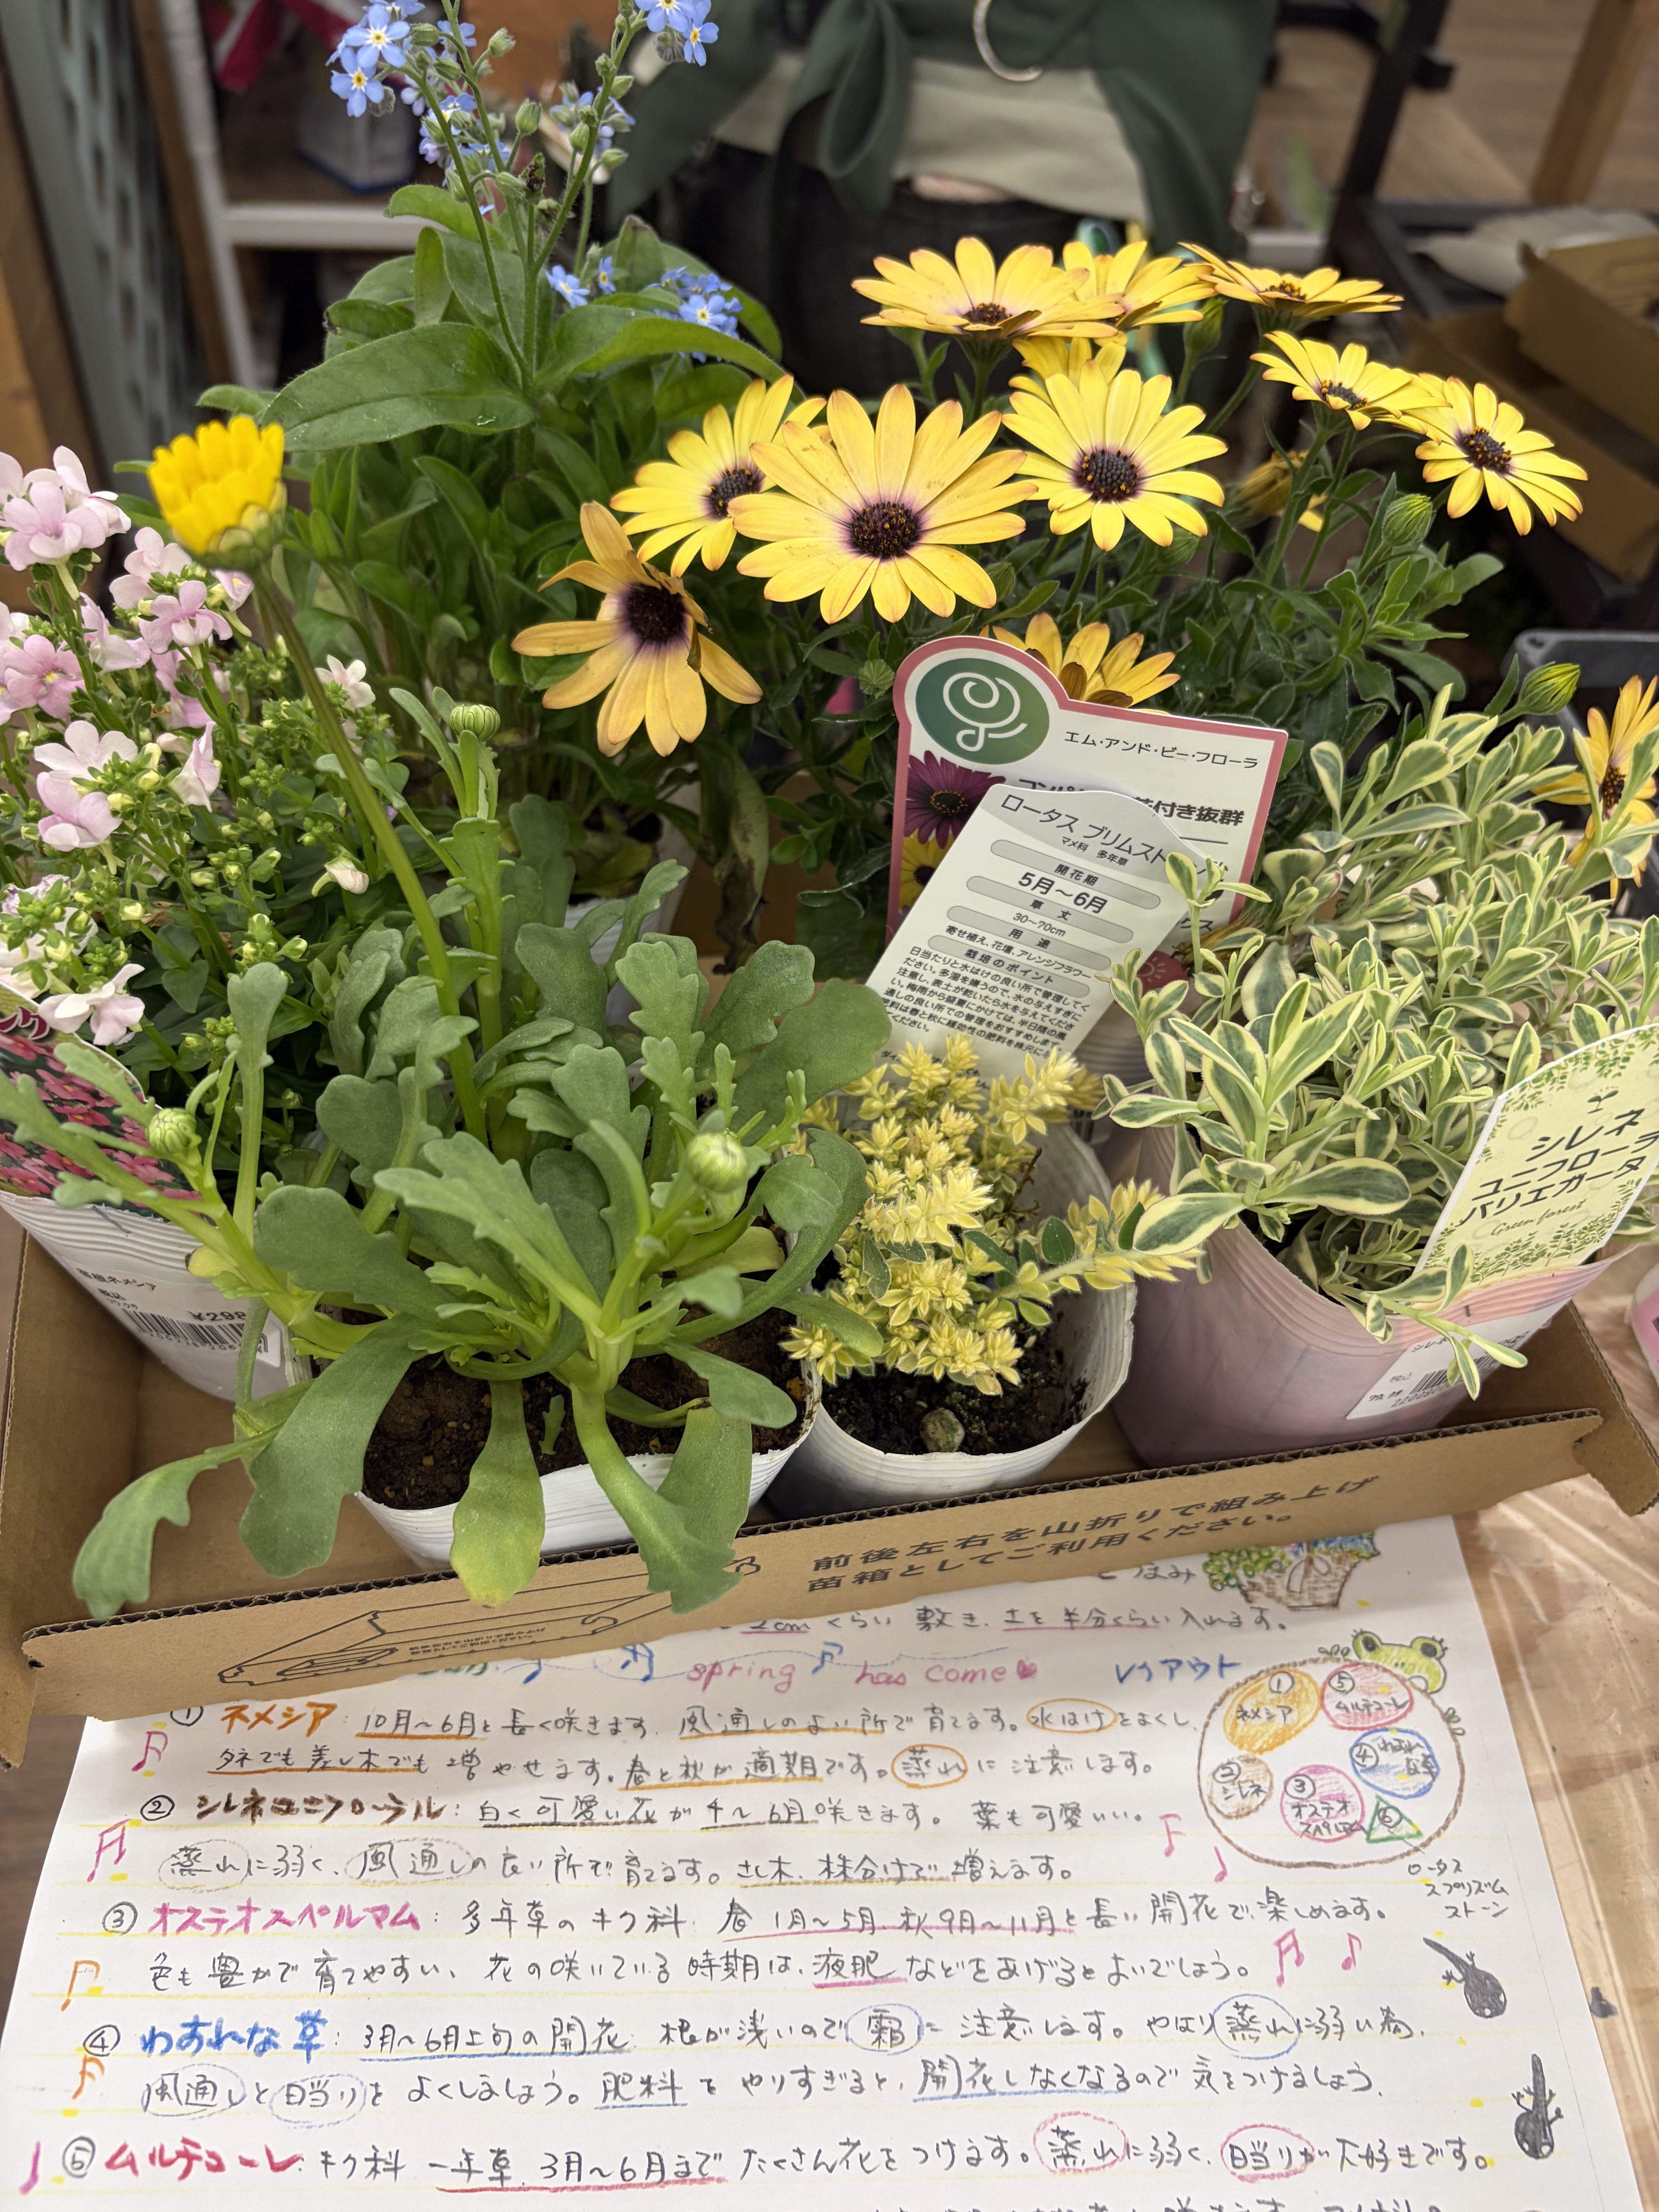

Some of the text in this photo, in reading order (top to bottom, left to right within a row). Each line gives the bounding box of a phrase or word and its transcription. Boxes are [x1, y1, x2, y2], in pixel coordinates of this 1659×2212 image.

[1001, 794, 1079, 833] ロータス
[1063, 836, 1129, 867] マメ科 多年草
[1054, 864, 1099, 886] 開花期
[964, 949, 1053, 984] 栽培のポイント
[1526, 1108, 1645, 1161] シレネ
[1472, 1130, 1659, 1201] ユニフローラ
[1455, 1156, 1646, 1228] バリエガータ
[1491, 1199, 1587, 1236] Green forest
[813, 1475, 1379, 1572] 前後左右を山折りで組み上げ
[808, 1514, 1291, 1592] 苗箱としてご利用ください。
[687, 1660, 1007, 1694] spring has come
[1236, 1704, 1292, 1726] ネメシア
[1221, 1781, 1268, 1800] シレネ
[1291, 1797, 1351, 1819] オステオ
[1408, 1859, 1463, 1875] ロータス
[1447, 1901, 1509, 1919] ストーン
